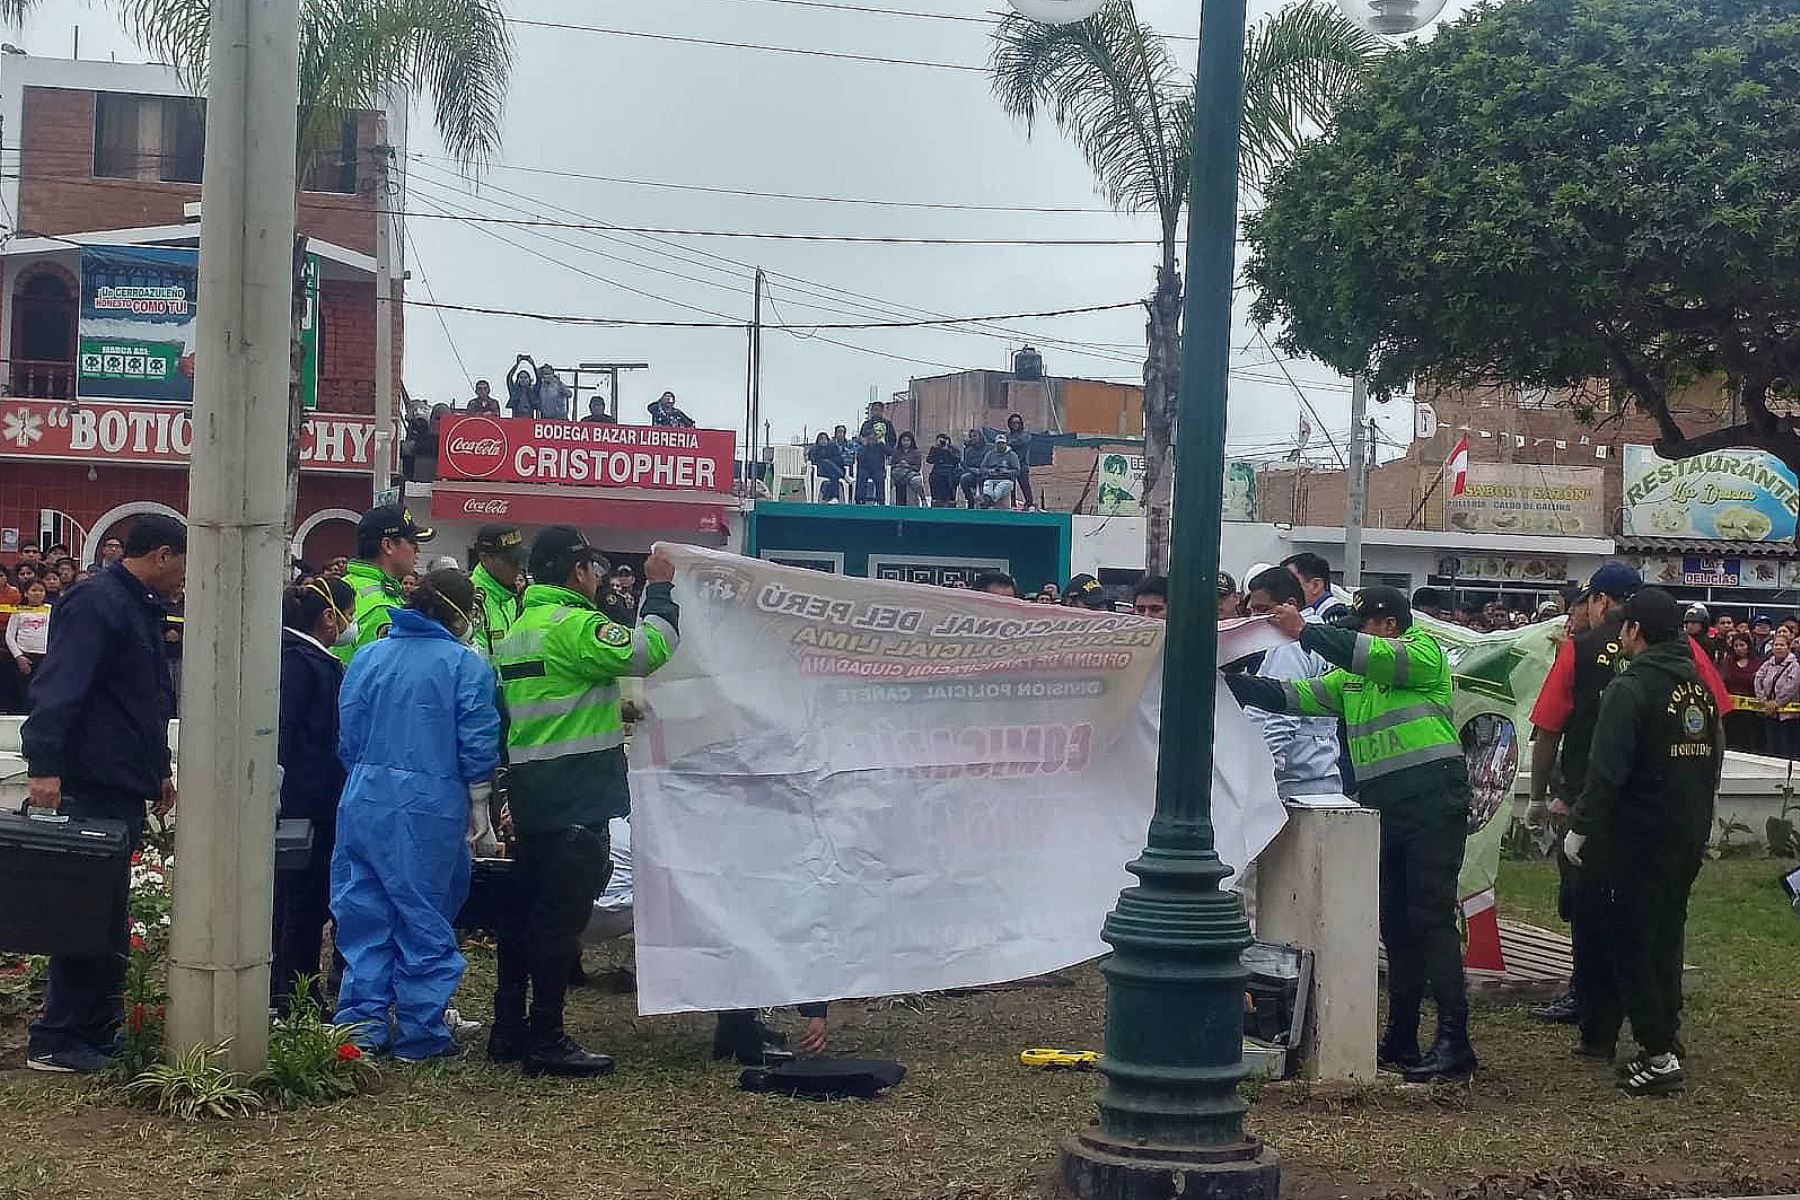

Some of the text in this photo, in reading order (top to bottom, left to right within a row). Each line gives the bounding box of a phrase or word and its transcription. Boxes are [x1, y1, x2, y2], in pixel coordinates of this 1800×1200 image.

[132, 301, 166, 314] COMO
[534, 424, 699, 449] BODEGA BAZAR LIBRERIA
[451, 437, 503, 456] Coca-Cola
[514, 445, 716, 488] CRISTOPHER
[1464, 484, 1516, 498] SABOR
[1626, 453, 1800, 517] RESTAURANTE
[463, 498, 511, 514] Coca-Cola
[1493, 500, 1522, 510] CALDO
[1685, 572, 1738, 586] DELICIAS
